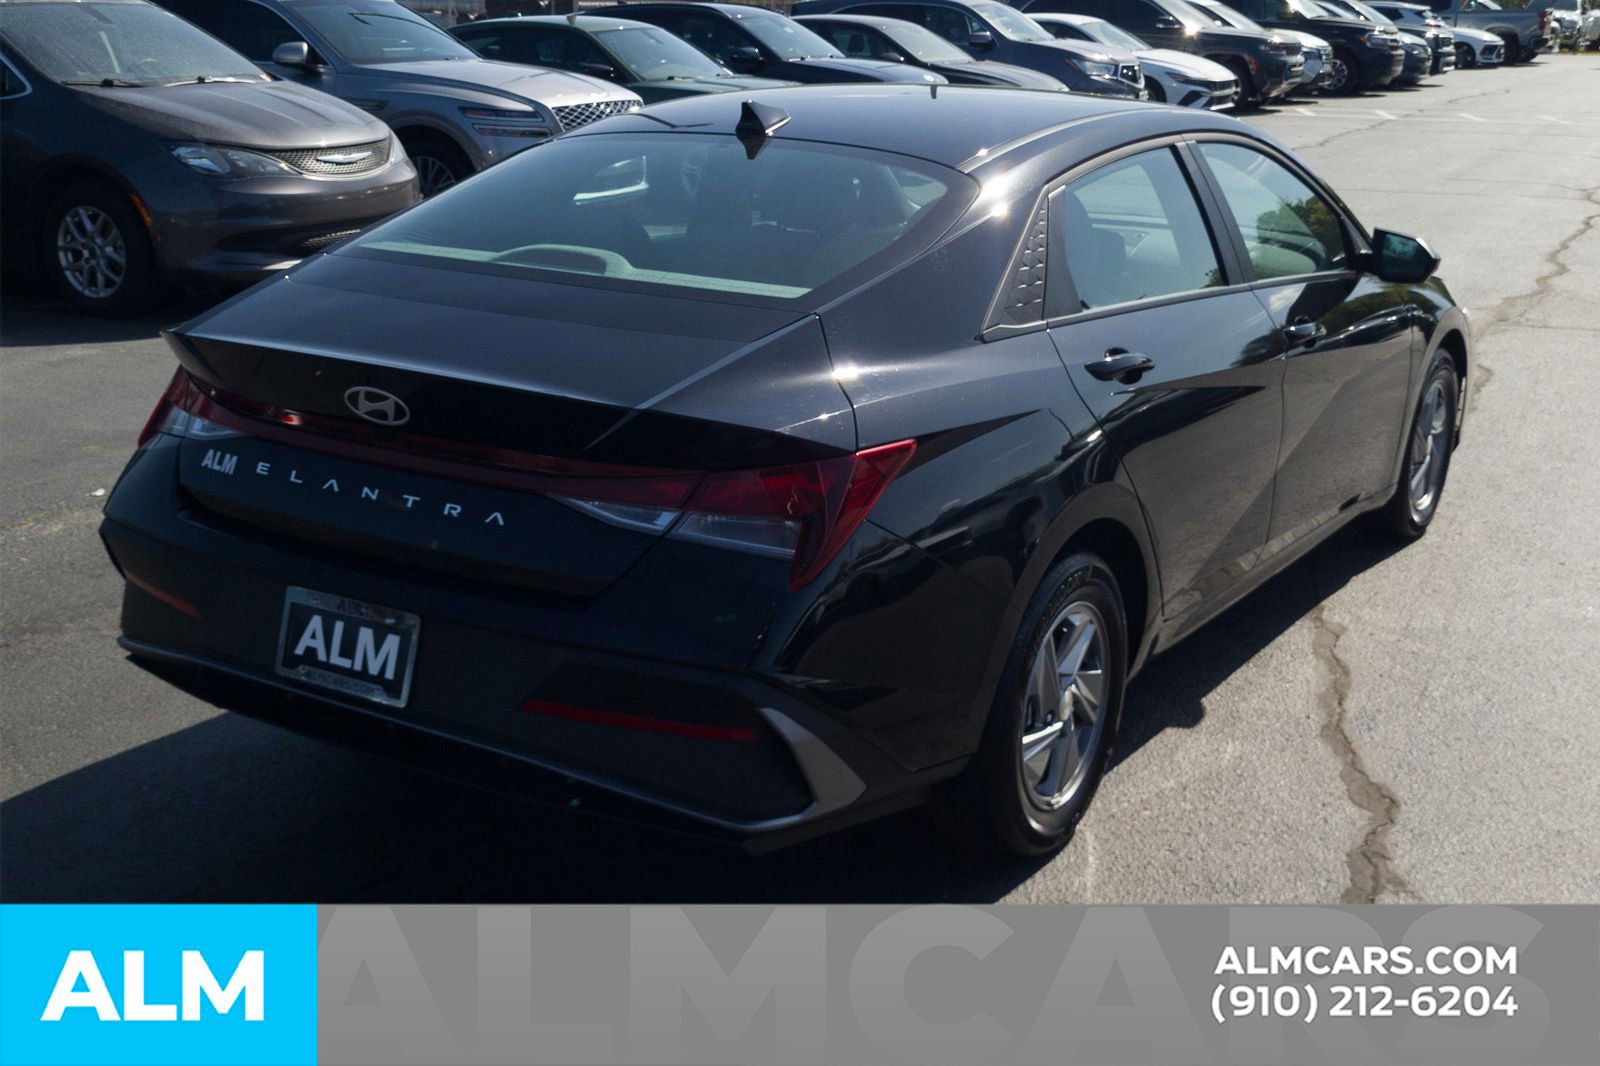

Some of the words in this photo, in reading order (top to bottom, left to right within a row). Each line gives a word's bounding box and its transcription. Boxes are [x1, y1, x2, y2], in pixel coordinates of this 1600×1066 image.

[201, 449, 238, 475] ALM
[255, 461, 505, 526] ELANTRA
[294, 614, 401, 680] ALM
